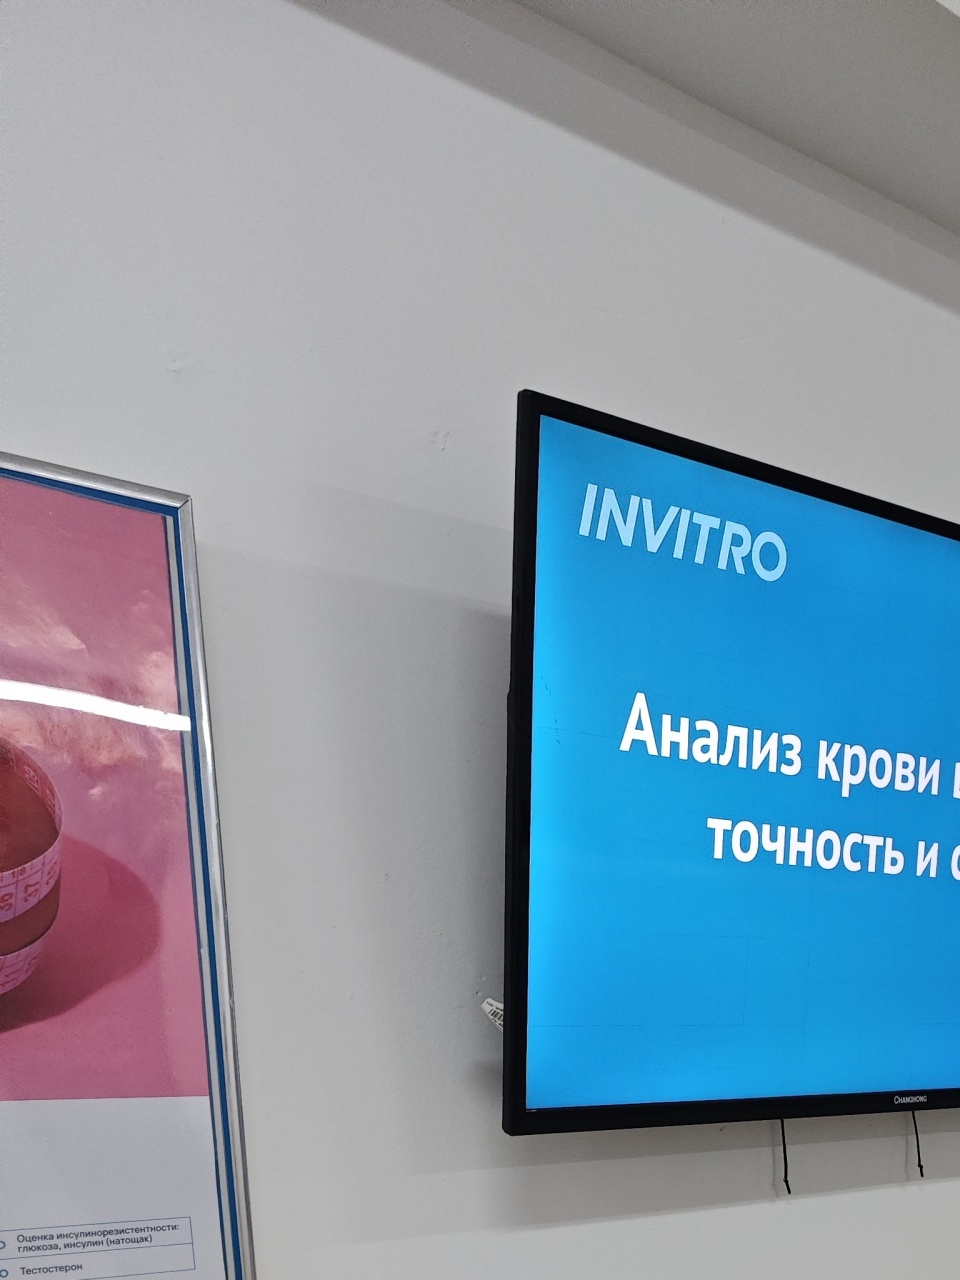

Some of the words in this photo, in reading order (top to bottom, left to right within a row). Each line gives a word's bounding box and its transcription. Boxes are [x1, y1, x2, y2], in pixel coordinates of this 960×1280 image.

[578, 482, 788, 582] INVITRO
[619, 691, 802, 777] Анализ
[817, 739, 941, 798] крови
[706, 816, 905, 876] точность
[915, 840, 939, 878] и
[16, 1233, 54, 1245] Оценка
[56, 1223, 180, 1240] инсулинорезистентности:
[18, 1243, 61, 1253] глюкоза,
[64, 1239, 104, 1250] инсулин
[106, 1234, 153, 1246] (натощак)
[20, 1263, 83, 1276] Тестостерон
